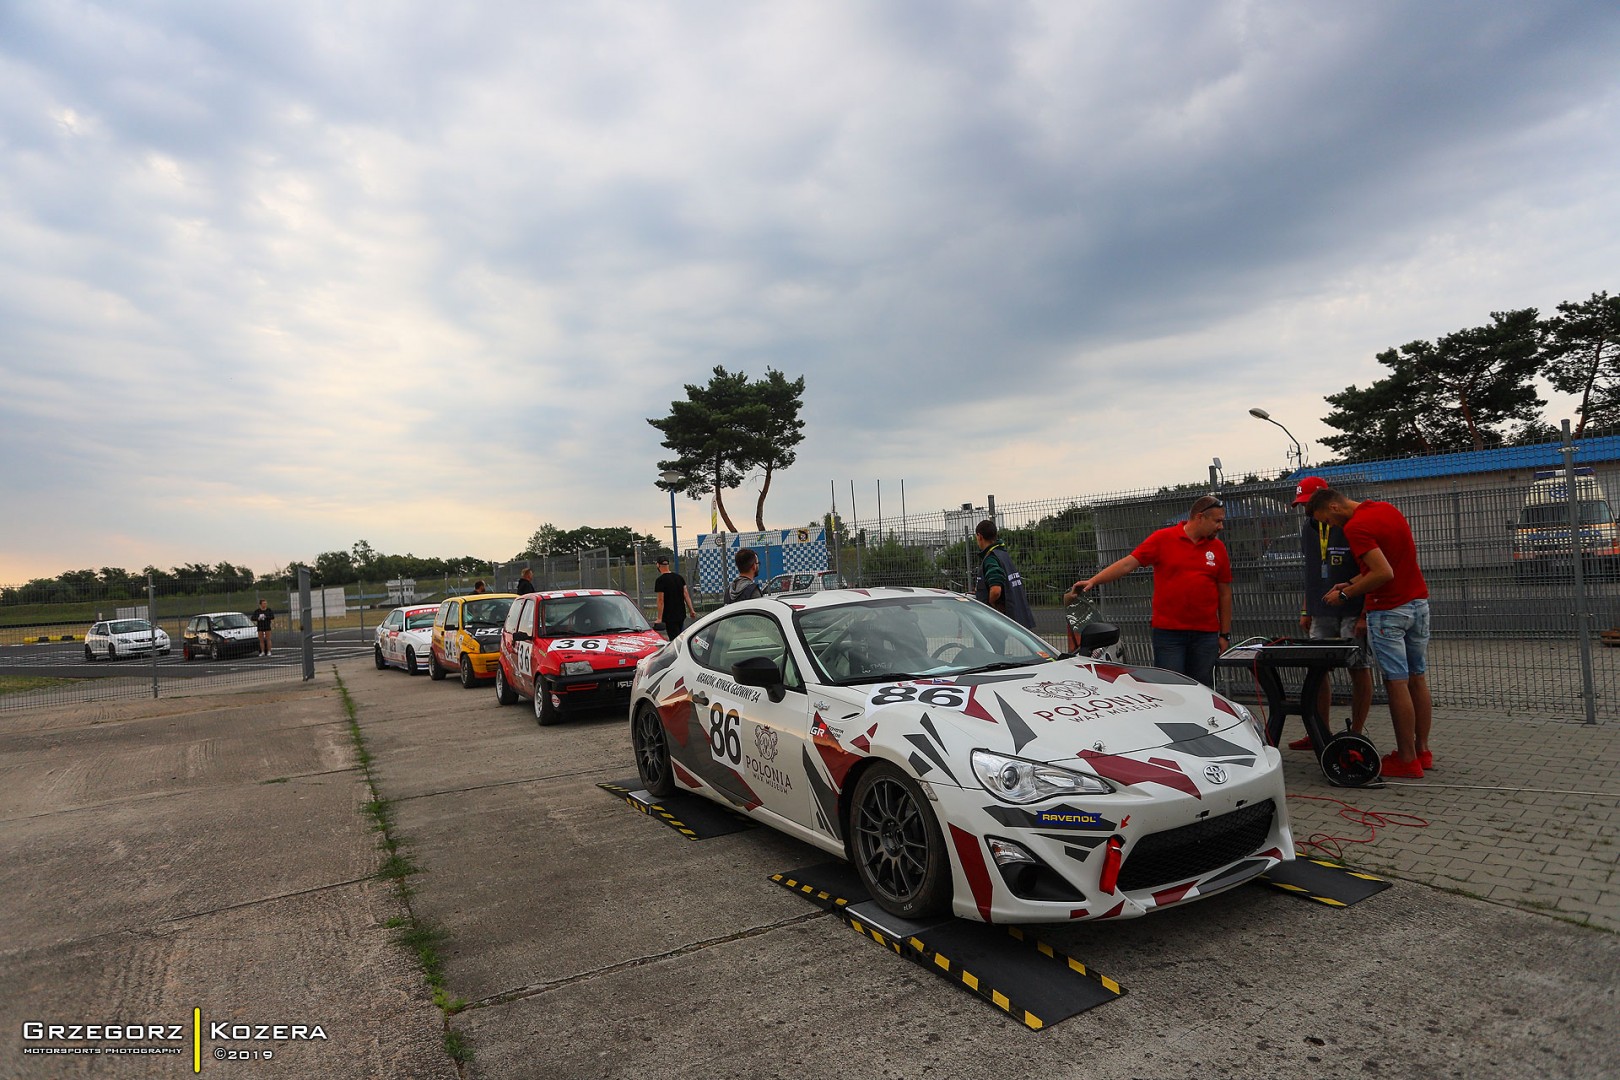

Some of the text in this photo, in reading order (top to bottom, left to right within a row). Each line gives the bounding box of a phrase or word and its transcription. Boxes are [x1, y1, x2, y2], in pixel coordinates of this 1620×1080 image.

[556, 639, 601, 650] 36
[519, 644, 530, 673] 36
[716, 678, 733, 693] RYNEK
[751, 691, 762, 703] 34
[871, 686, 965, 707] 86
[1032, 693, 1164, 722] POLONIA
[1068, 703, 1163, 723] WAX MUSEUM
[710, 702, 742, 765] 86
[811, 726, 825, 738] GR
[745, 754, 793, 790] POLONIA
[753, 773, 789, 795] WAX MUSEUM
[1042, 813, 1097, 823] RAVENOL
